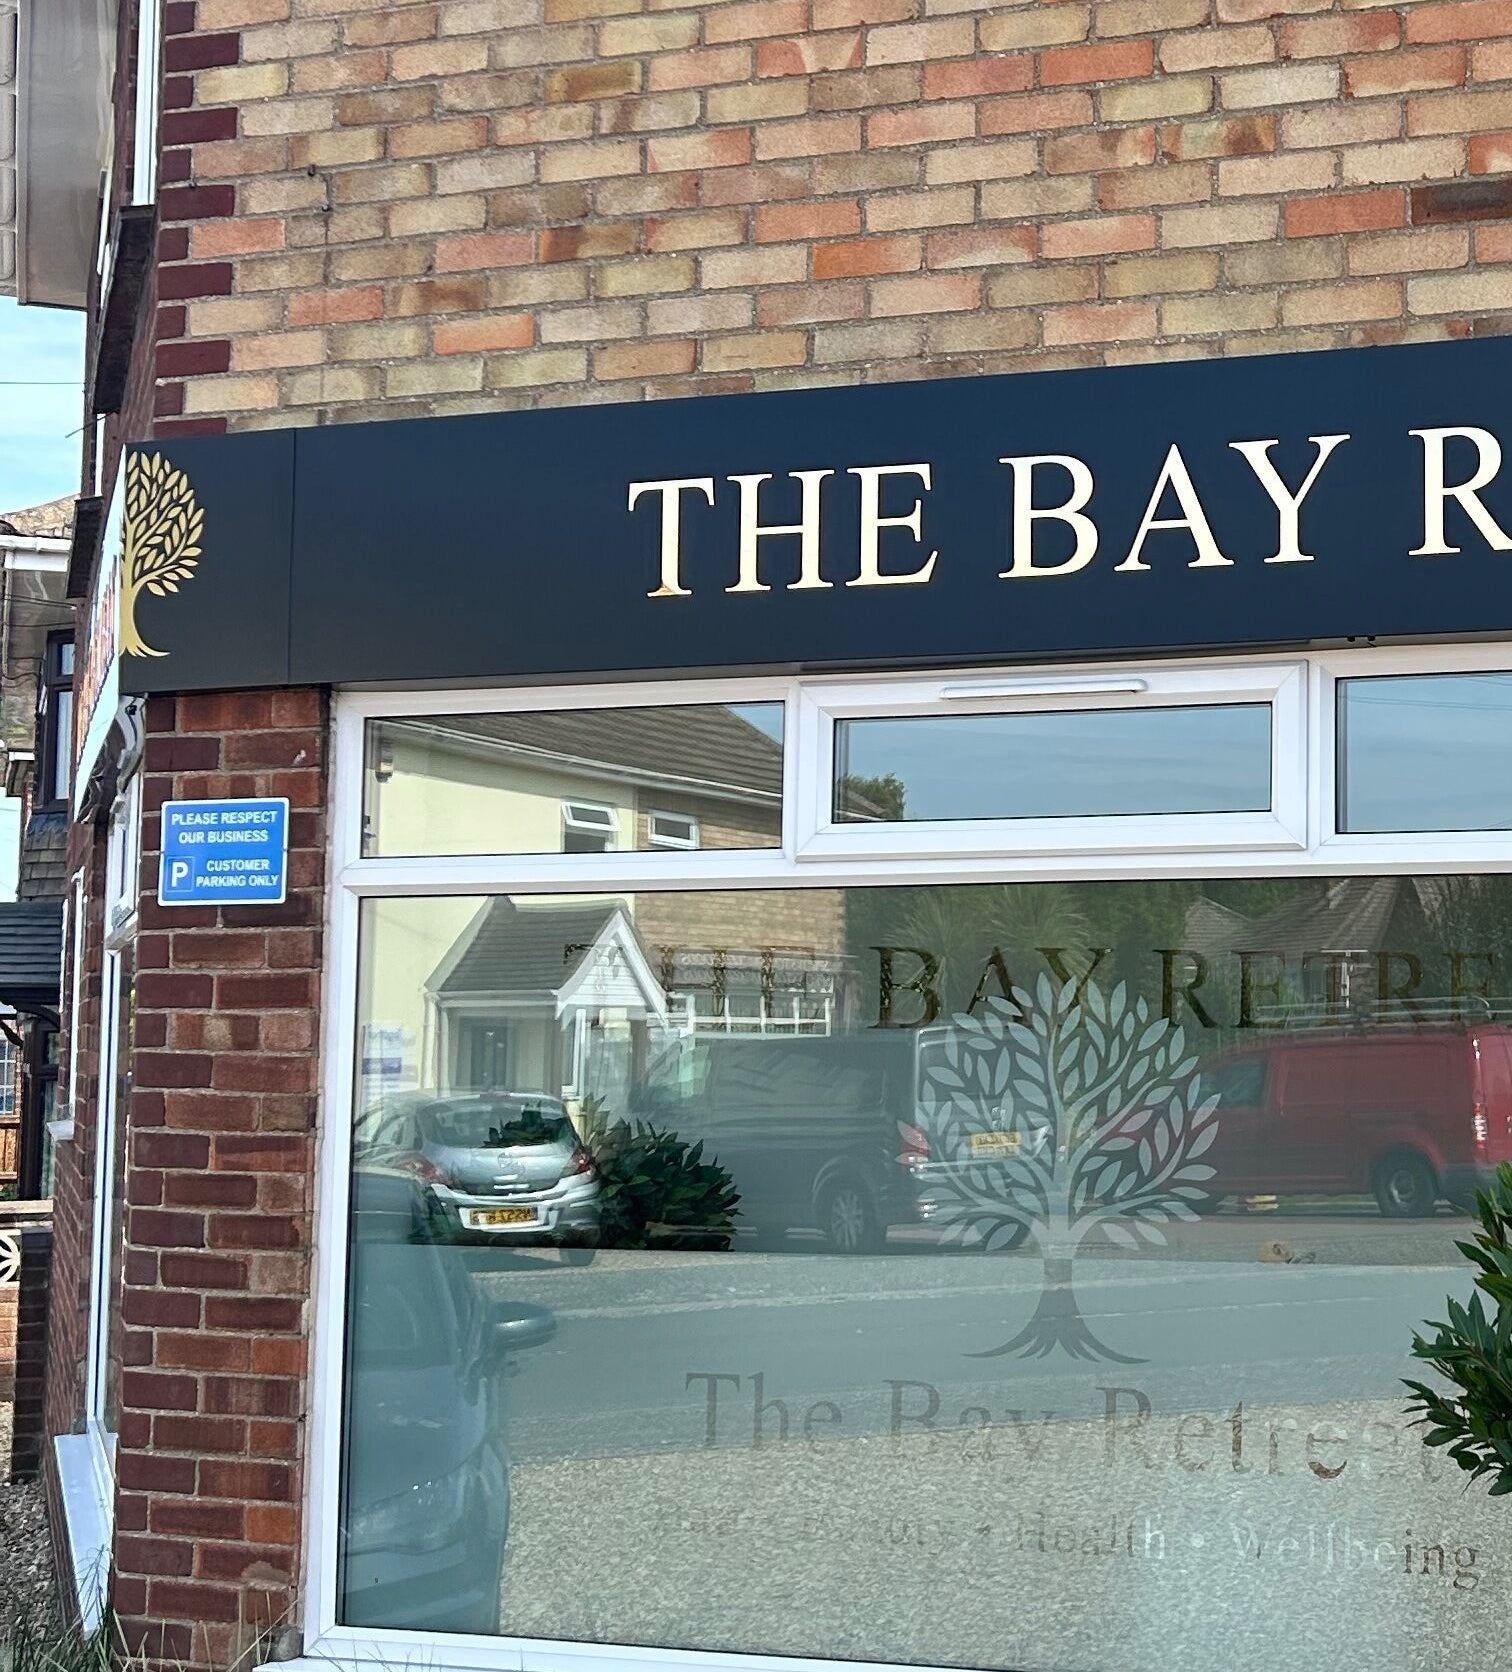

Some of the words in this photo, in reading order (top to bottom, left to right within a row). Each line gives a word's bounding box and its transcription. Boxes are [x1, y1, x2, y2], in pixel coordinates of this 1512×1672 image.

[628, 463, 938, 597] THE
[997, 433, 1350, 579] BAY
[171, 812, 219, 826] PLEASE
[220, 810, 278, 824] RESPECT
[178, 831, 205, 844] OUR
[207, 829, 269, 843] BUSINESS
[171, 861, 189, 888] P
[206, 859, 271, 872] CUSTOMER
[195, 875, 247, 888] PARKING
[248, 873, 280, 887] ONLY
[868, 946, 1114, 1030] BAY
[685, 1371, 844, 1456] The
[1229, 1520, 1480, 1590] Wellbeing
